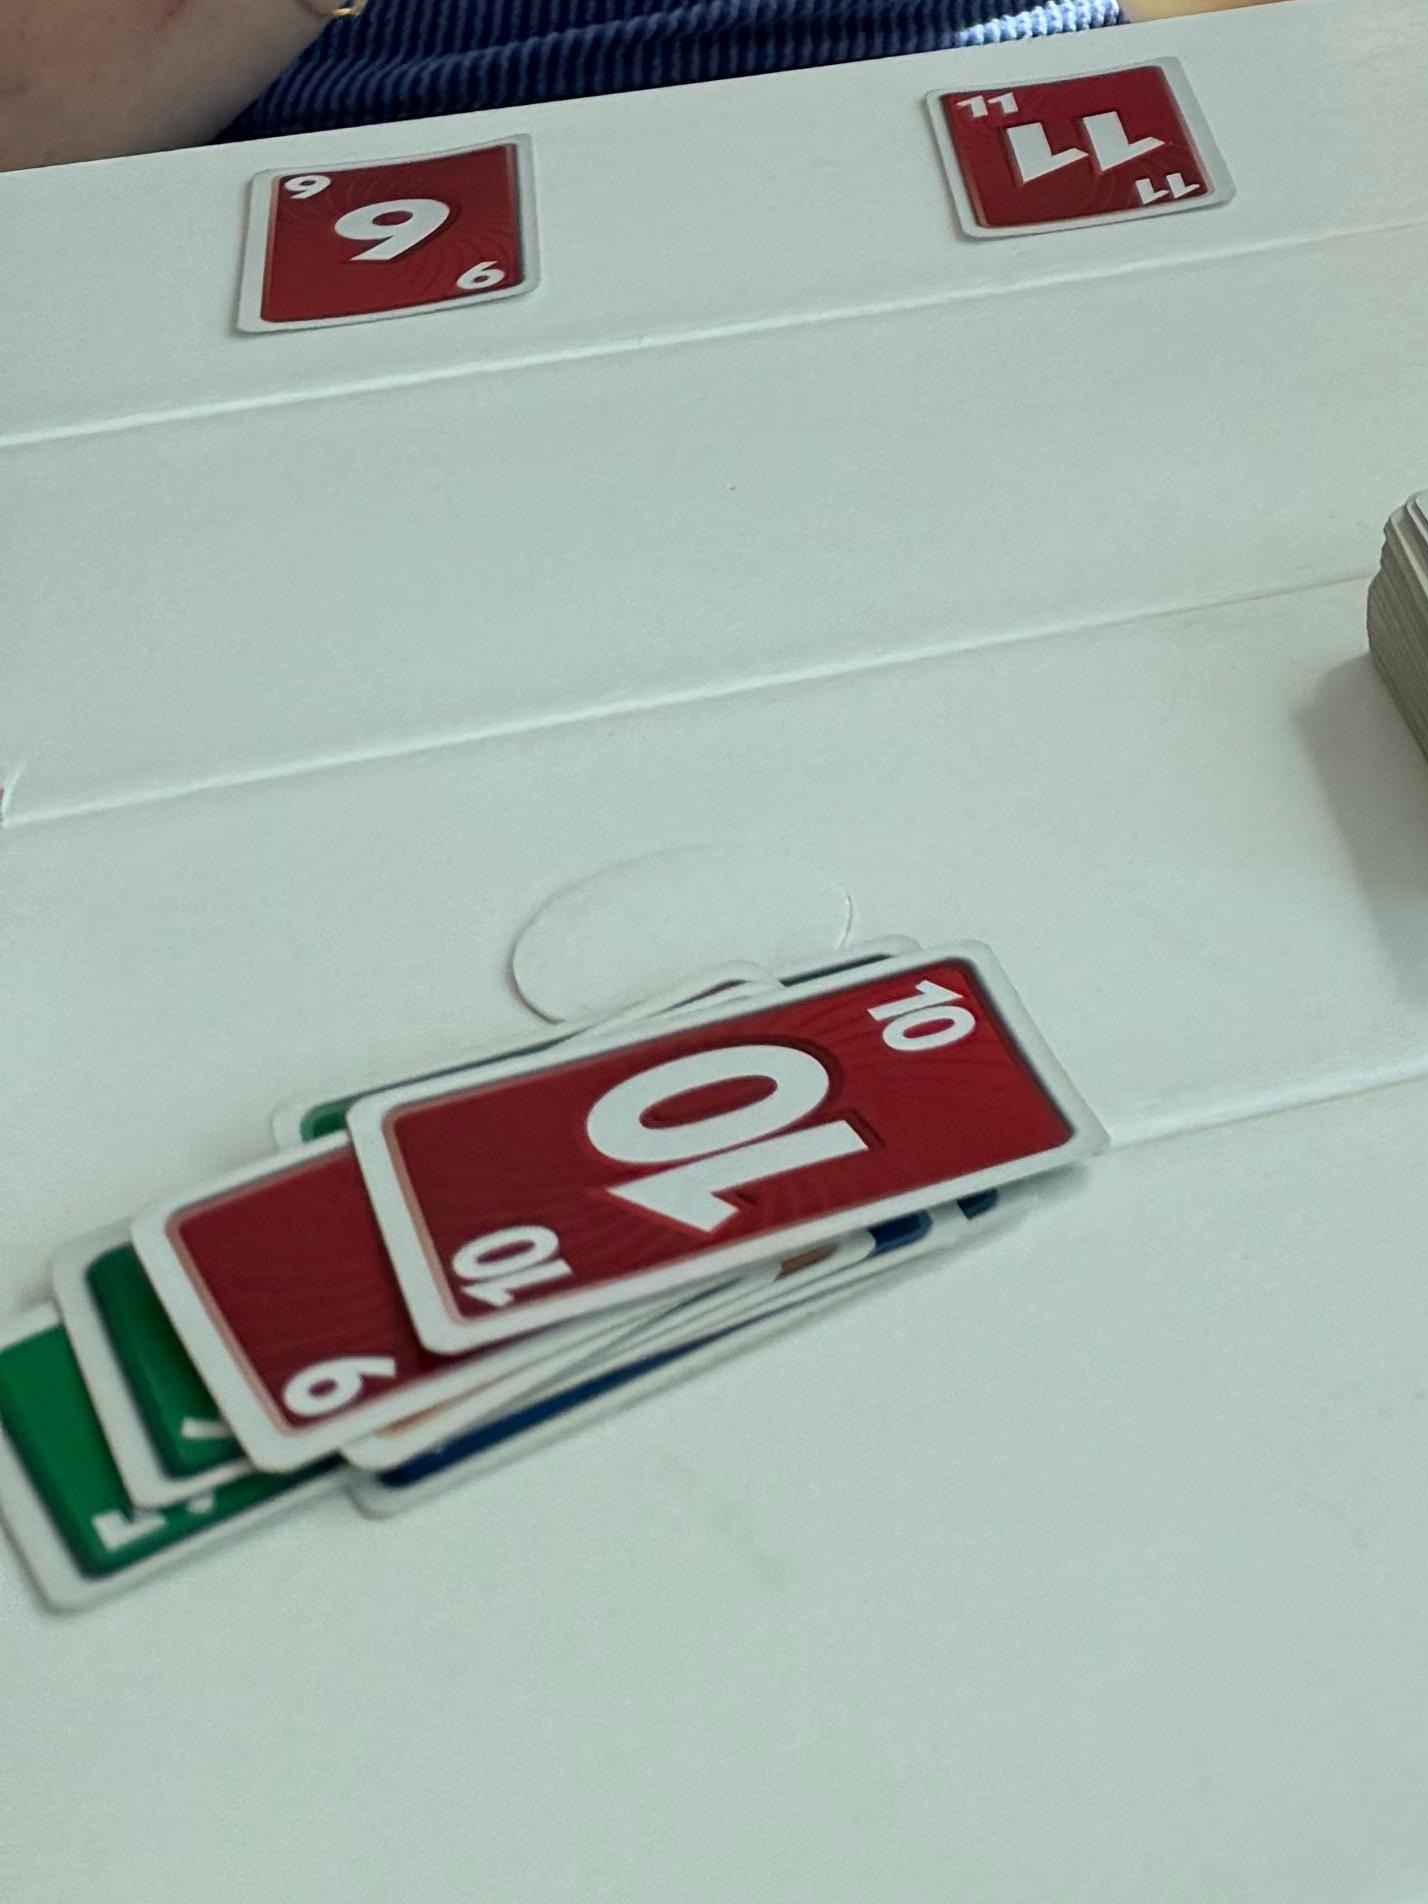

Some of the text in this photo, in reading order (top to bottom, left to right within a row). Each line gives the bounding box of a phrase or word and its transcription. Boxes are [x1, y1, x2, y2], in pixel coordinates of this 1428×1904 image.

[956, 92, 1019, 118] 11
[1006, 111, 1165, 184] 11
[1134, 172, 1200, 205] 11
[334, 198, 450, 261] 9
[867, 979, 976, 1052] 10
[586, 1044, 870, 1233] 10
[451, 1225, 572, 1308] 10
